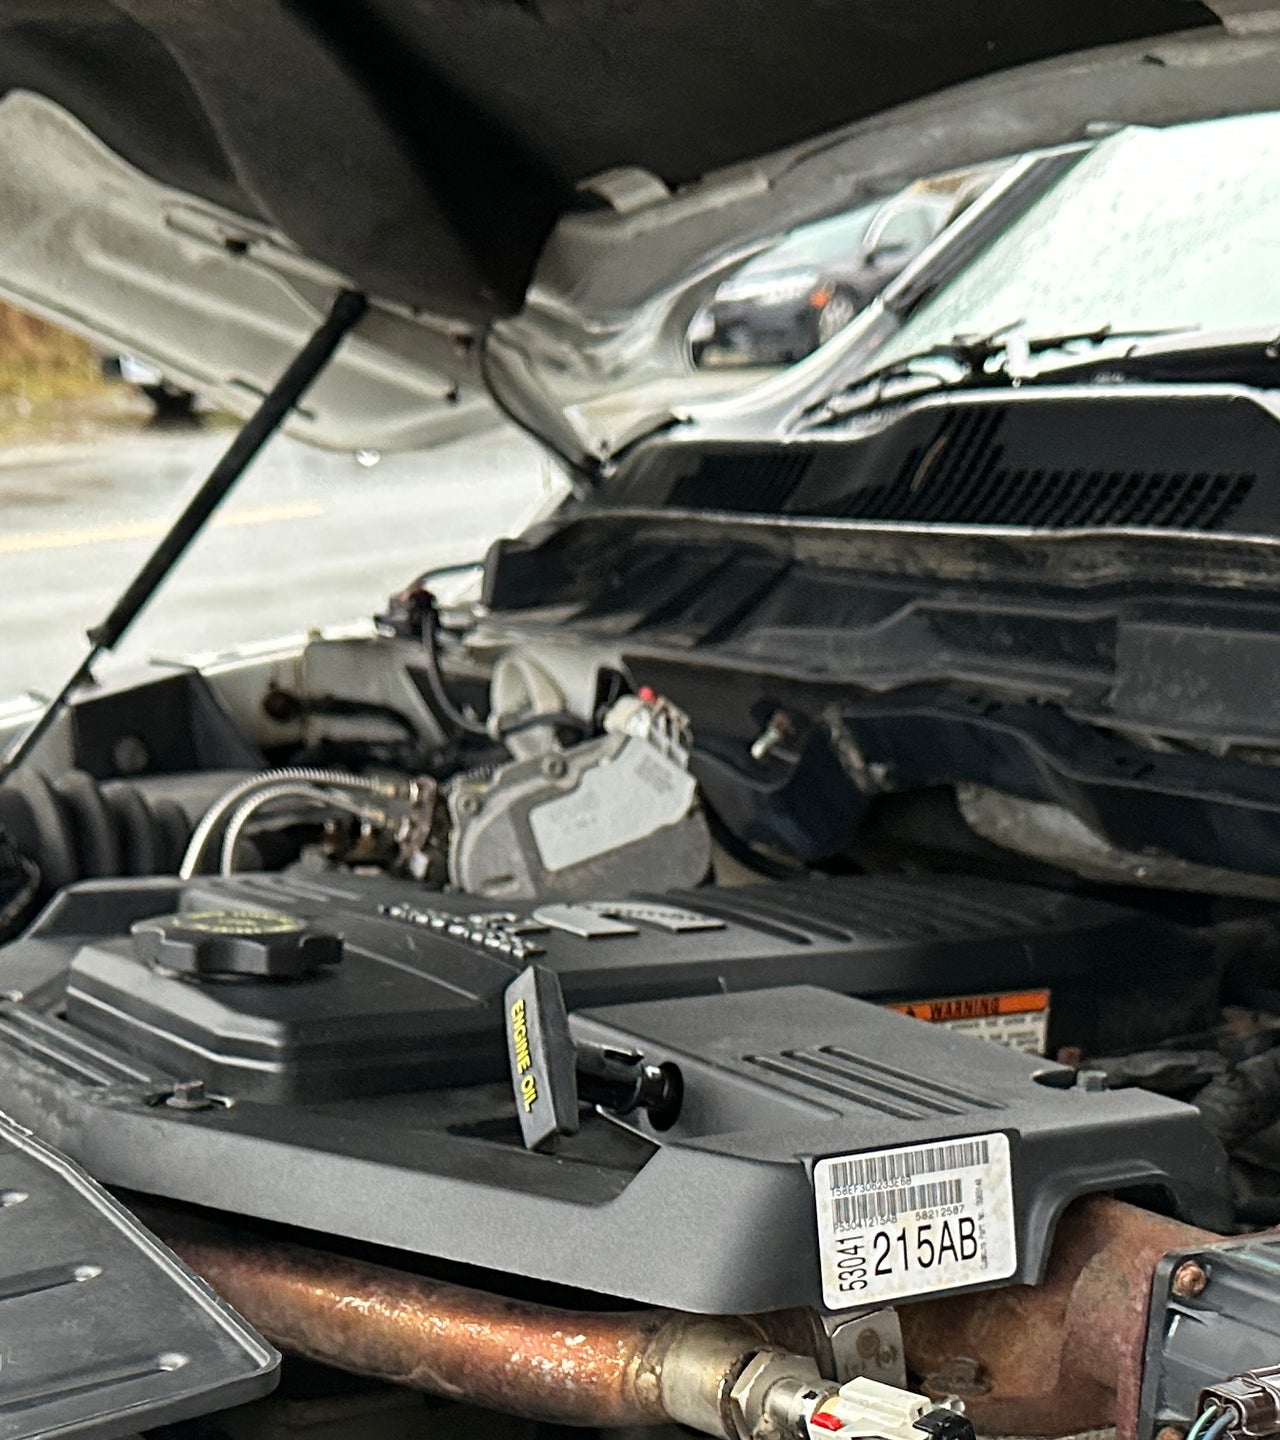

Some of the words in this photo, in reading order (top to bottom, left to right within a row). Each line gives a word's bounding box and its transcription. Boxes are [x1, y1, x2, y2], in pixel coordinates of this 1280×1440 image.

[511, 998, 532, 1074] ENGINE
[929, 997, 1001, 1022] WARNING
[520, 1075, 537, 1113] OIL
[835, 1235, 868, 1292] 53041
[873, 1217, 978, 1276] 215AB
